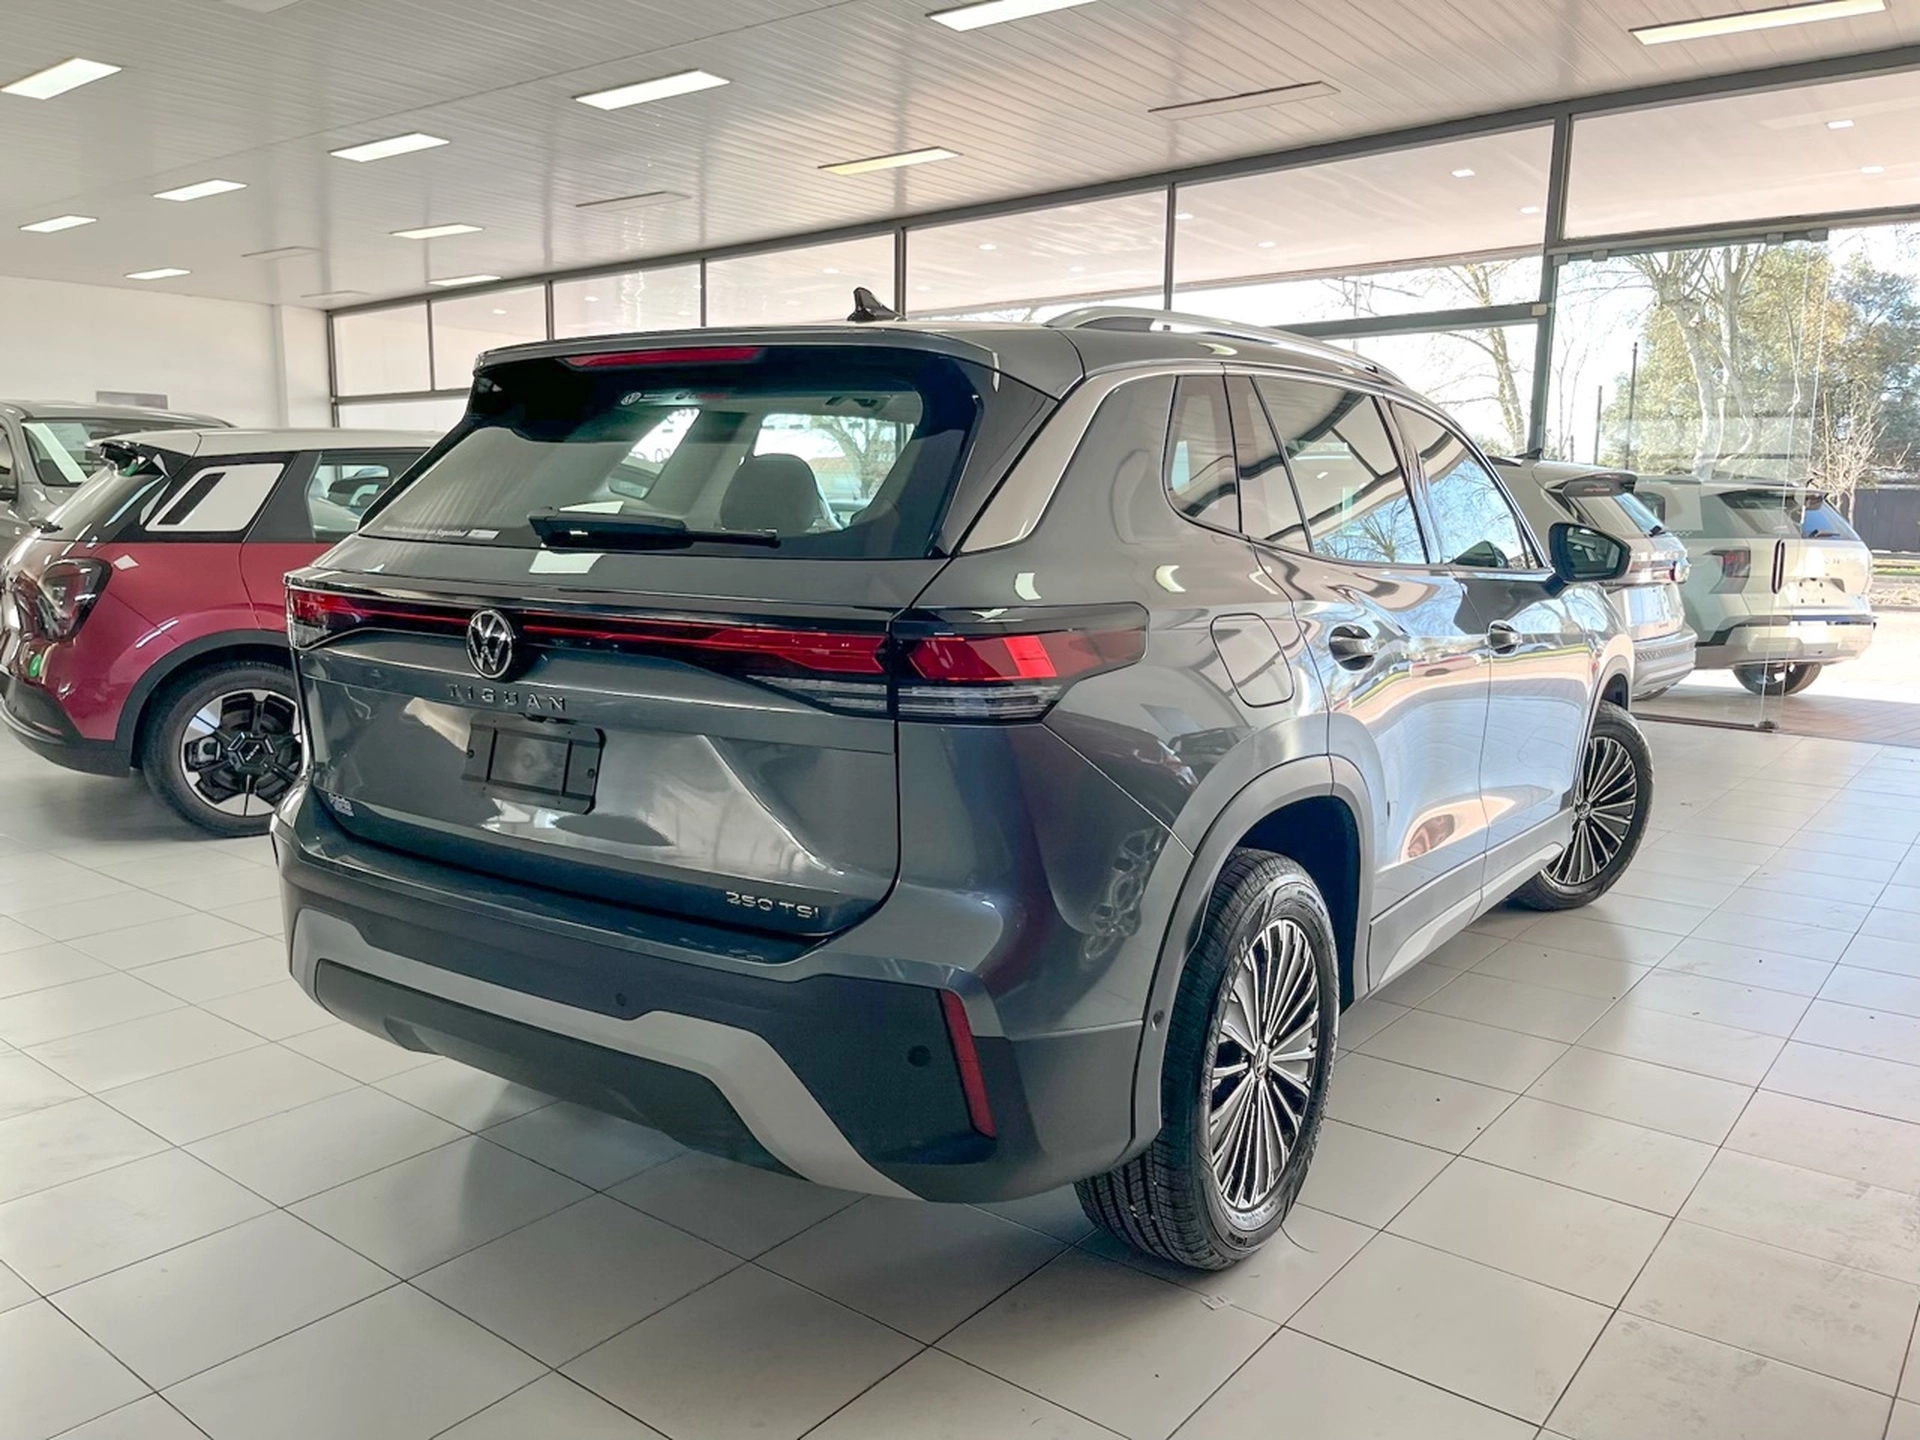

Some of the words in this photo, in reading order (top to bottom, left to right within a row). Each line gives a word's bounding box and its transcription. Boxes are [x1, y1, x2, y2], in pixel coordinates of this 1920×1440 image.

[447, 683, 566, 712] TIGUAN
[725, 890, 773, 911] 250
[778, 901, 819, 919] TSI
